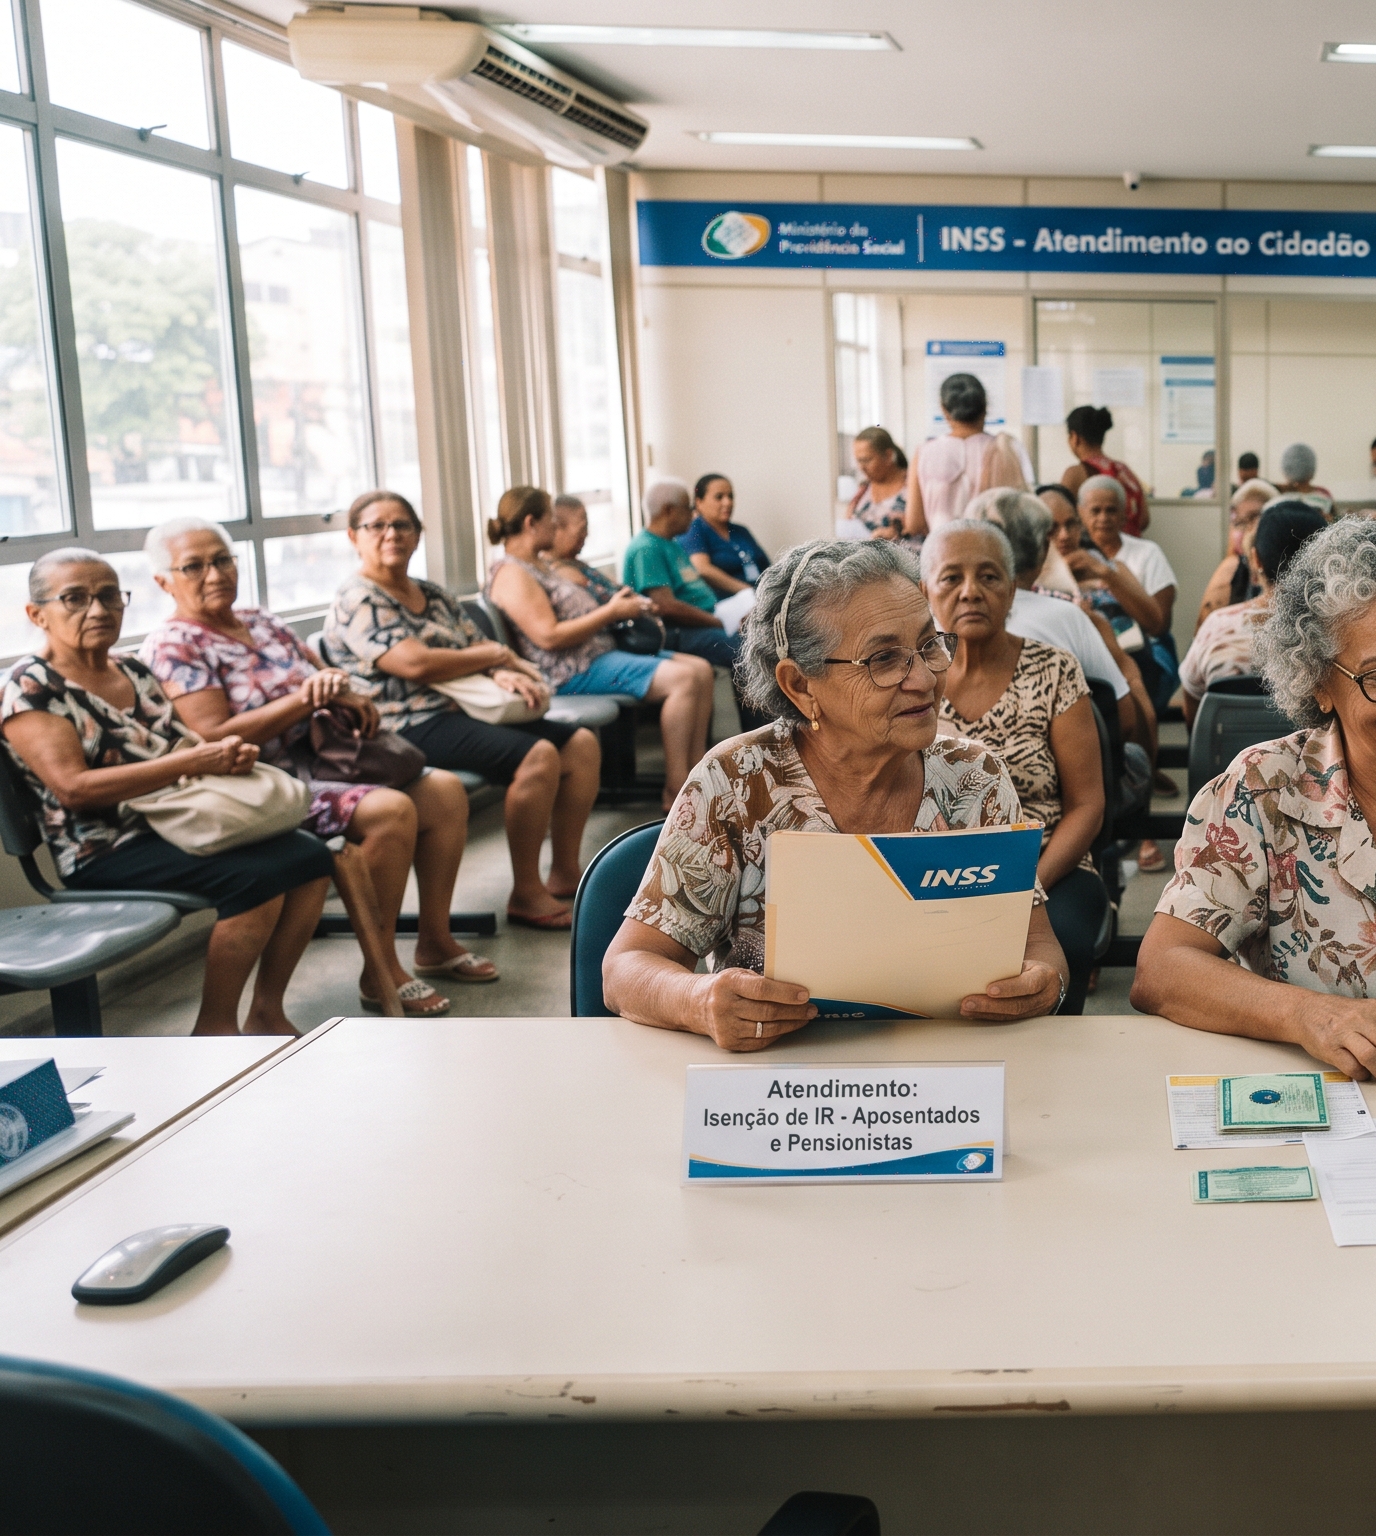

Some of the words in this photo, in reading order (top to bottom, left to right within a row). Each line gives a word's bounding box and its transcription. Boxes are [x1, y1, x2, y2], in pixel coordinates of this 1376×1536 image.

[939, 226, 1006, 252] INSS
[1033, 227, 1209, 256] Atendimento
[1215, 236, 1251, 256] ao
[1258, 230, 1371, 259] Cidadão
[920, 864, 1000, 888] INSS
[767, 1079, 918, 1099] Atendimento:
[703, 1107, 780, 1131] Isenção
[785, 1106, 809, 1126] de
[815, 1107, 835, 1126] IR
[852, 1105, 981, 1131] Aposentados
[770, 1136, 782, 1152] e
[788, 1132, 913, 1152] Pensionistas
